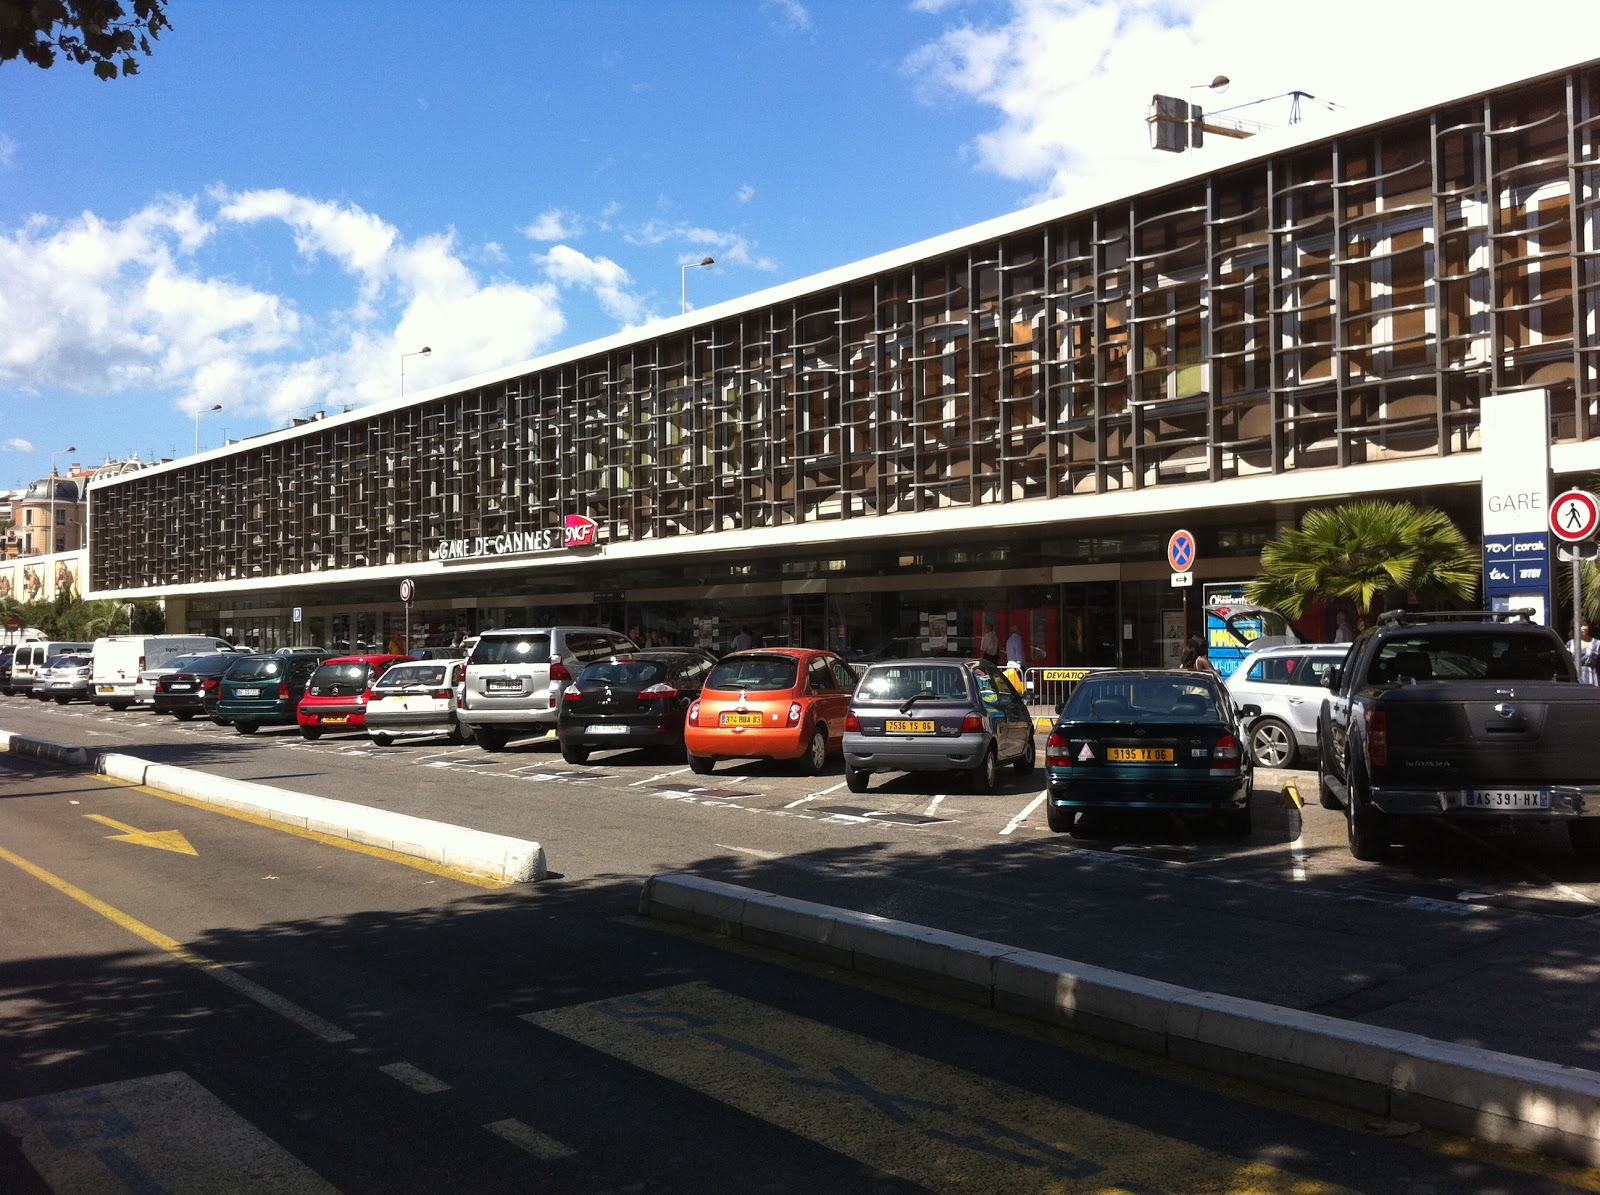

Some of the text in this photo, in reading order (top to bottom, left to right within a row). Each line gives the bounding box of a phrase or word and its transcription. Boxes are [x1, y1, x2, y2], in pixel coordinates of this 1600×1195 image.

[1488, 492, 1541, 512] GARE
[565, 524, 593, 541] SNCF
[438, 530, 552, 559] GARE DE CANNES
[1485, 543, 1511, 553] TGV
[1489, 567, 1510, 580] ter
[1046, 671, 1089, 680] DEVIATIO
[889, 721, 907, 730] 7536
[910, 721, 918, 730] YS
[922, 721, 932, 730] 06
[1113, 749, 1166, 760] 9195 YX 06
[1405, 760, 1451, 768] NAVARA
[1476, 793, 1539, 806] AS-391-HX
